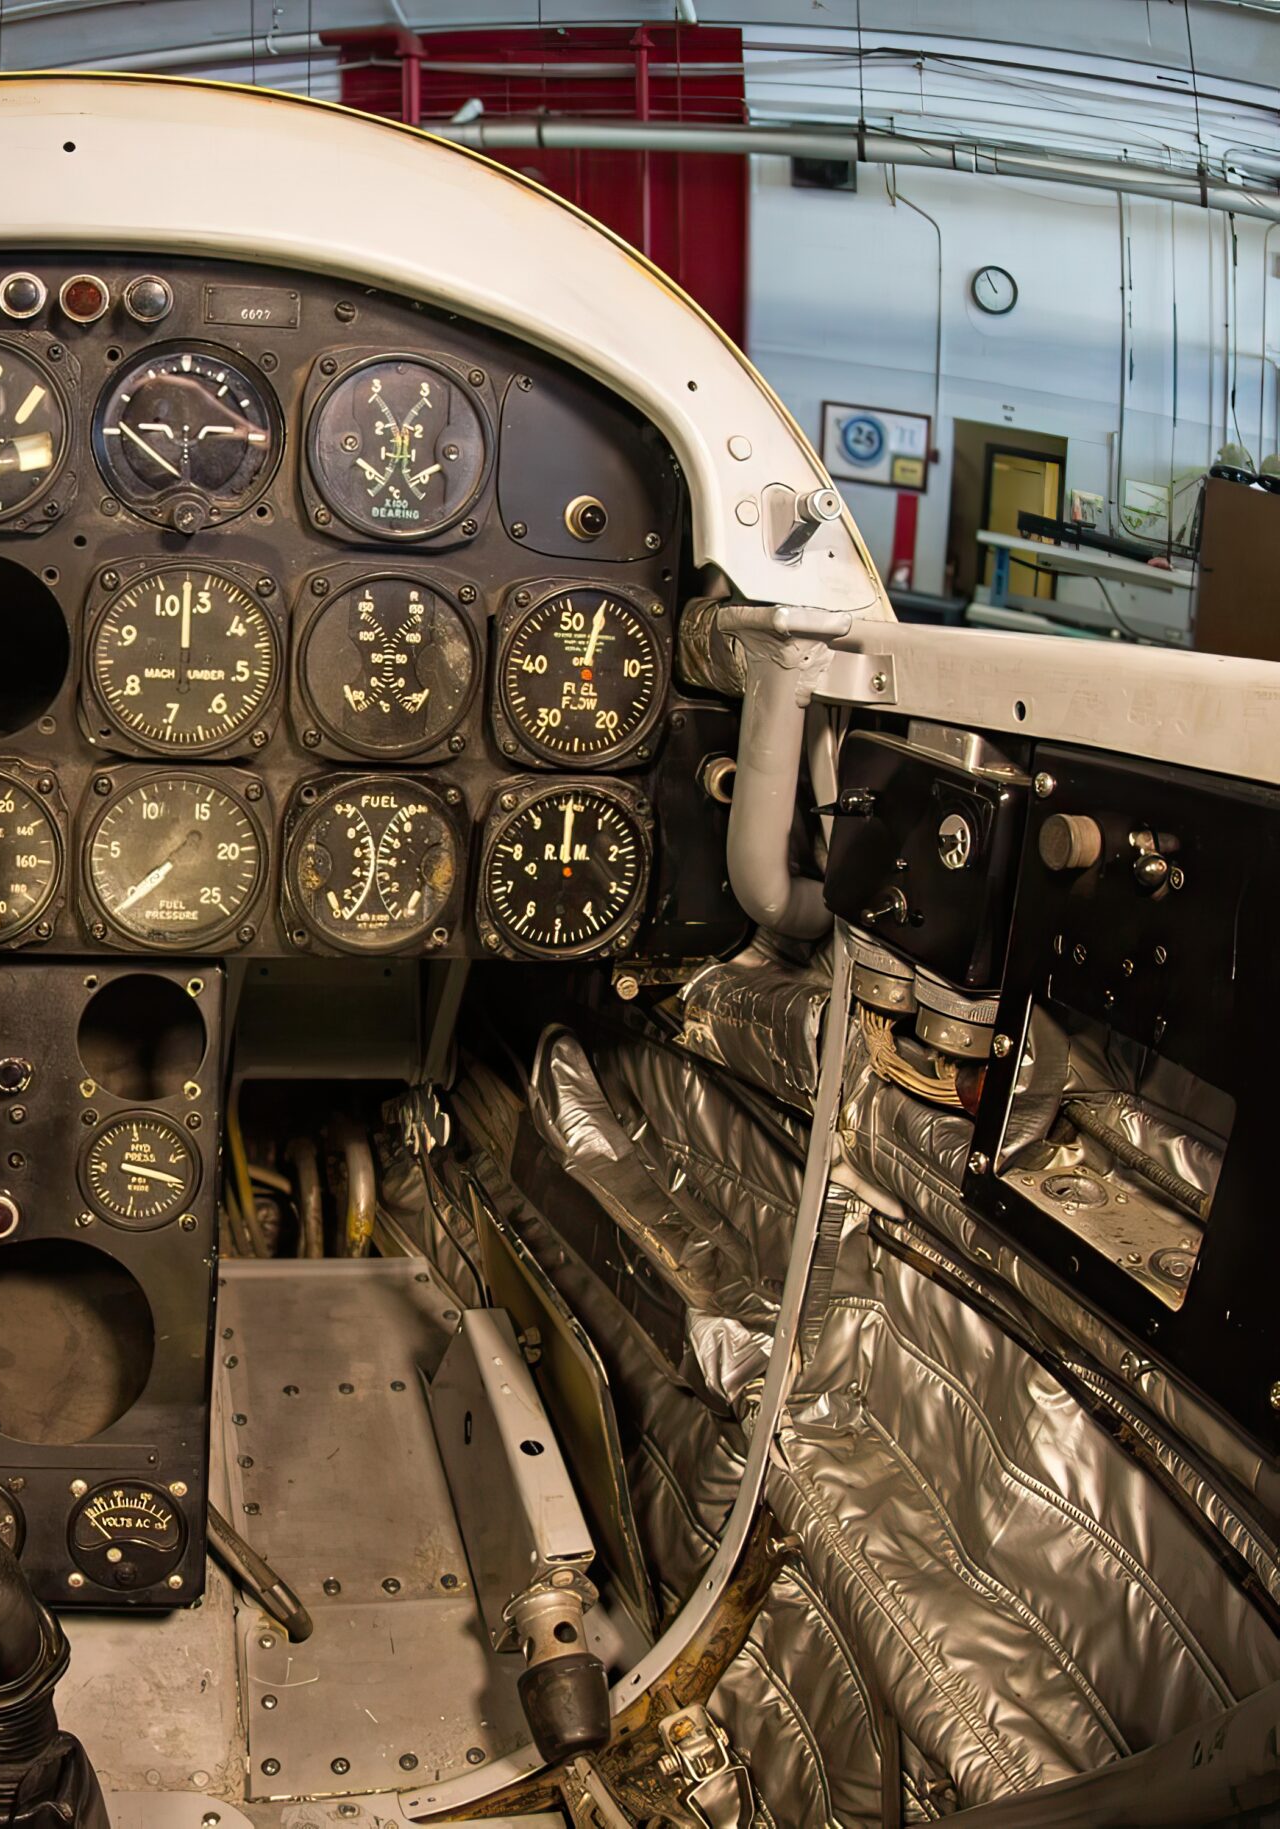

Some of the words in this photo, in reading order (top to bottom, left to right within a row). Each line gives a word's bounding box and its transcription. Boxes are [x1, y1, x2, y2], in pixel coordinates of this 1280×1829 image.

[372, 508, 420, 520] BEARING
[365, 590, 373, 600] L
[156, 594, 180, 616] 1.0
[192, 592, 212, 614] .3
[226, 616, 246, 636] .4
[560, 612, 584, 631] 50
[117, 624, 138, 646] .9
[371, 653, 384, 664] 50
[396, 654, 408, 664] 50
[522, 655, 548, 674] 40
[144, 668, 175, 679] MACH
[187, 670, 225, 680] UMBER
[231, 660, 250, 682] .5
[623, 658, 641, 678] 10
[123, 674, 140, 696] .8
[208, 692, 227, 714] .6
[162, 703, 180, 724] .7
[536, 708, 561, 728] 30
[596, 710, 618, 729] 20
[361, 796, 398, 808] FUEL
[142, 802, 158, 820] 10
[195, 803, 210, 820] 15
[16, 826, 34, 836] 140
[533, 818, 542, 830] 9
[598, 818, 602, 830] 1
[110, 842, 120, 858] 5
[393, 838, 400, 849] 6
[216, 843, 240, 860] 20
[354, 847, 362, 858] 6
[513, 844, 523, 860] 8
[608, 845, 619, 862] 2
[16, 854, 37, 868] 160
[352, 867, 360, 878] 4
[344, 888, 352, 900] 2
[391, 882, 399, 892] 2
[506, 881, 514, 893] 7
[609, 882, 617, 894] 3
[200, 887, 222, 904] 25
[160, 900, 186, 909] FUEL
[526, 902, 536, 917] 6
[583, 901, 592, 915] 4
[145, 910, 199, 920] PRESSURE
[554, 918, 562, 930] 5
[102, 1516, 132, 1528] VOLTS
[136, 1518, 150, 1528] AC
